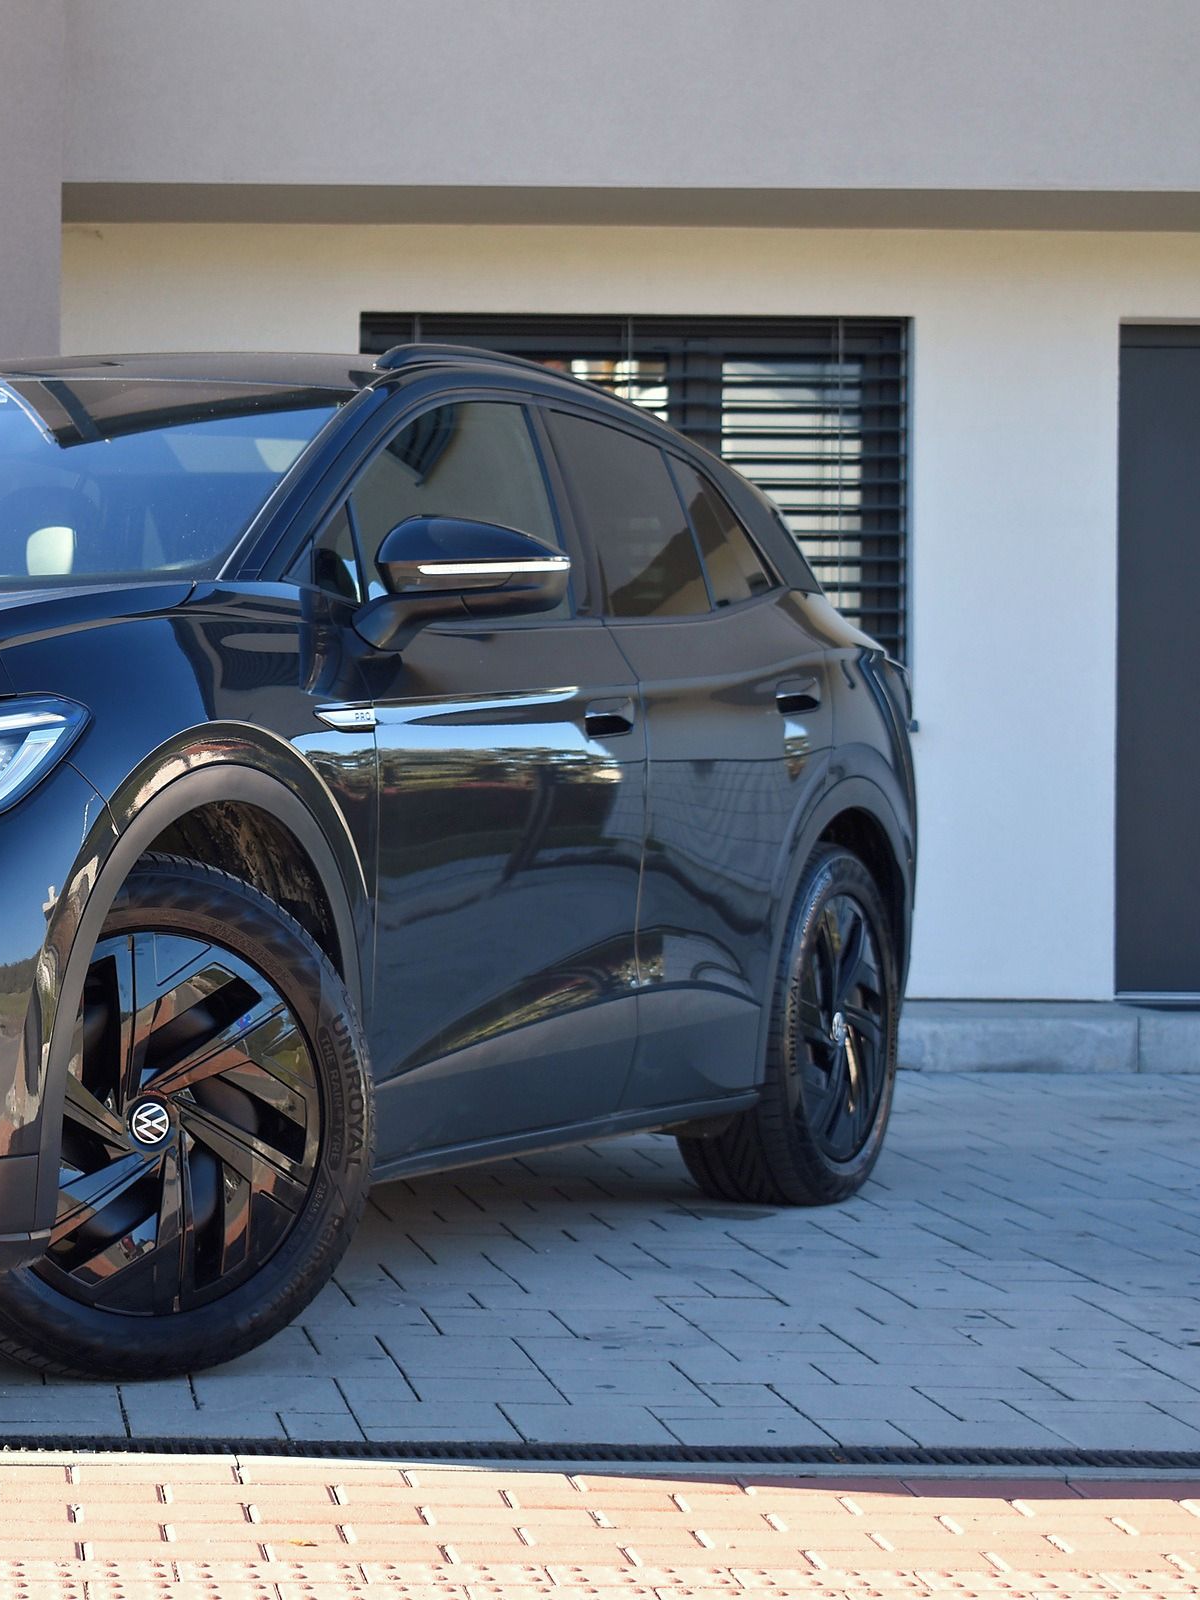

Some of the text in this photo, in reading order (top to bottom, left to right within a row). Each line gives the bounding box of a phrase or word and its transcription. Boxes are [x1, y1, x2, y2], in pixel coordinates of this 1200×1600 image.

[354, 711, 371, 721] PRO
[320, 1034, 344, 1163] THE RAIN TYRE
[330, 1012, 365, 1174] UNIROYAL
